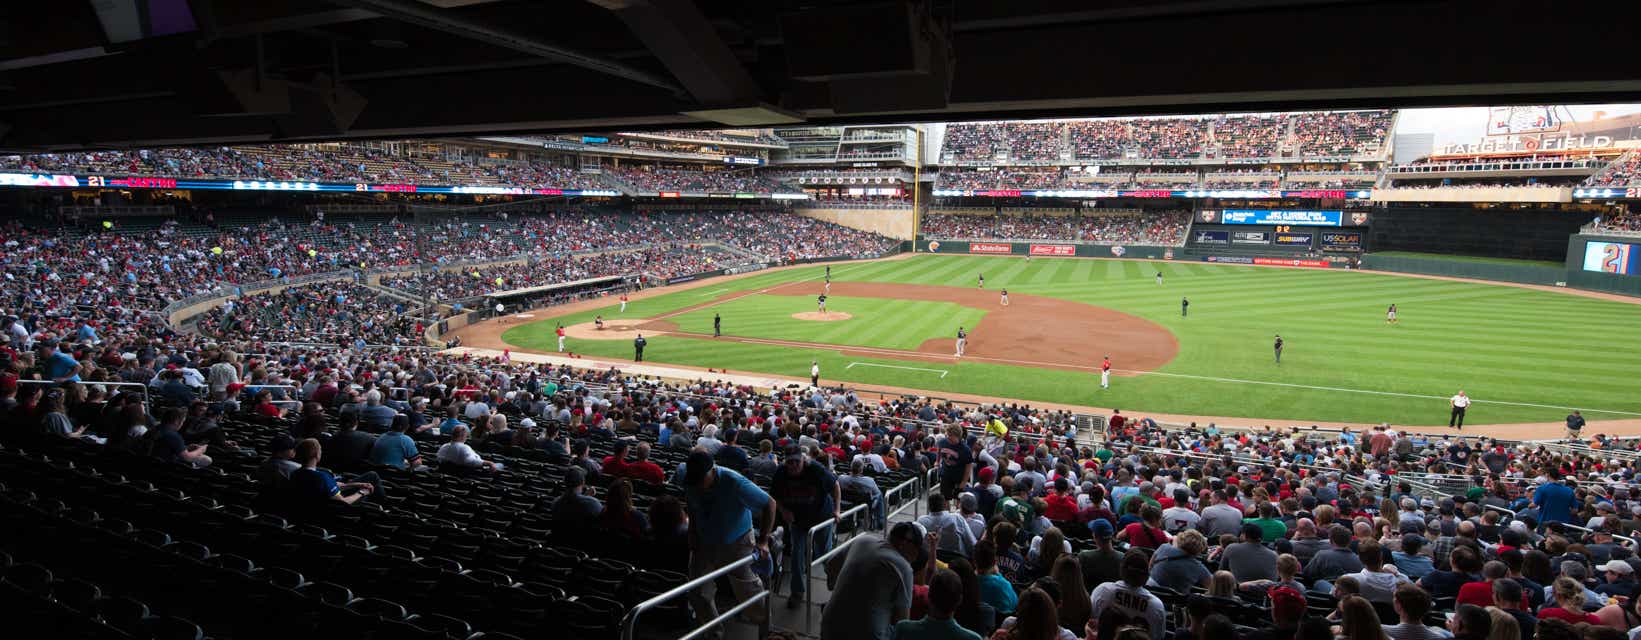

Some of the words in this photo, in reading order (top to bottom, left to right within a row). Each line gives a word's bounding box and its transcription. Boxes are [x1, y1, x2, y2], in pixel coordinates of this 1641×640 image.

[1444, 140, 1521, 154] TARGET
[1543, 136, 1611, 149] FIELD
[88, 176, 105, 187] 21
[355, 183, 368, 192] 21
[1602, 243, 1631, 275] 21
